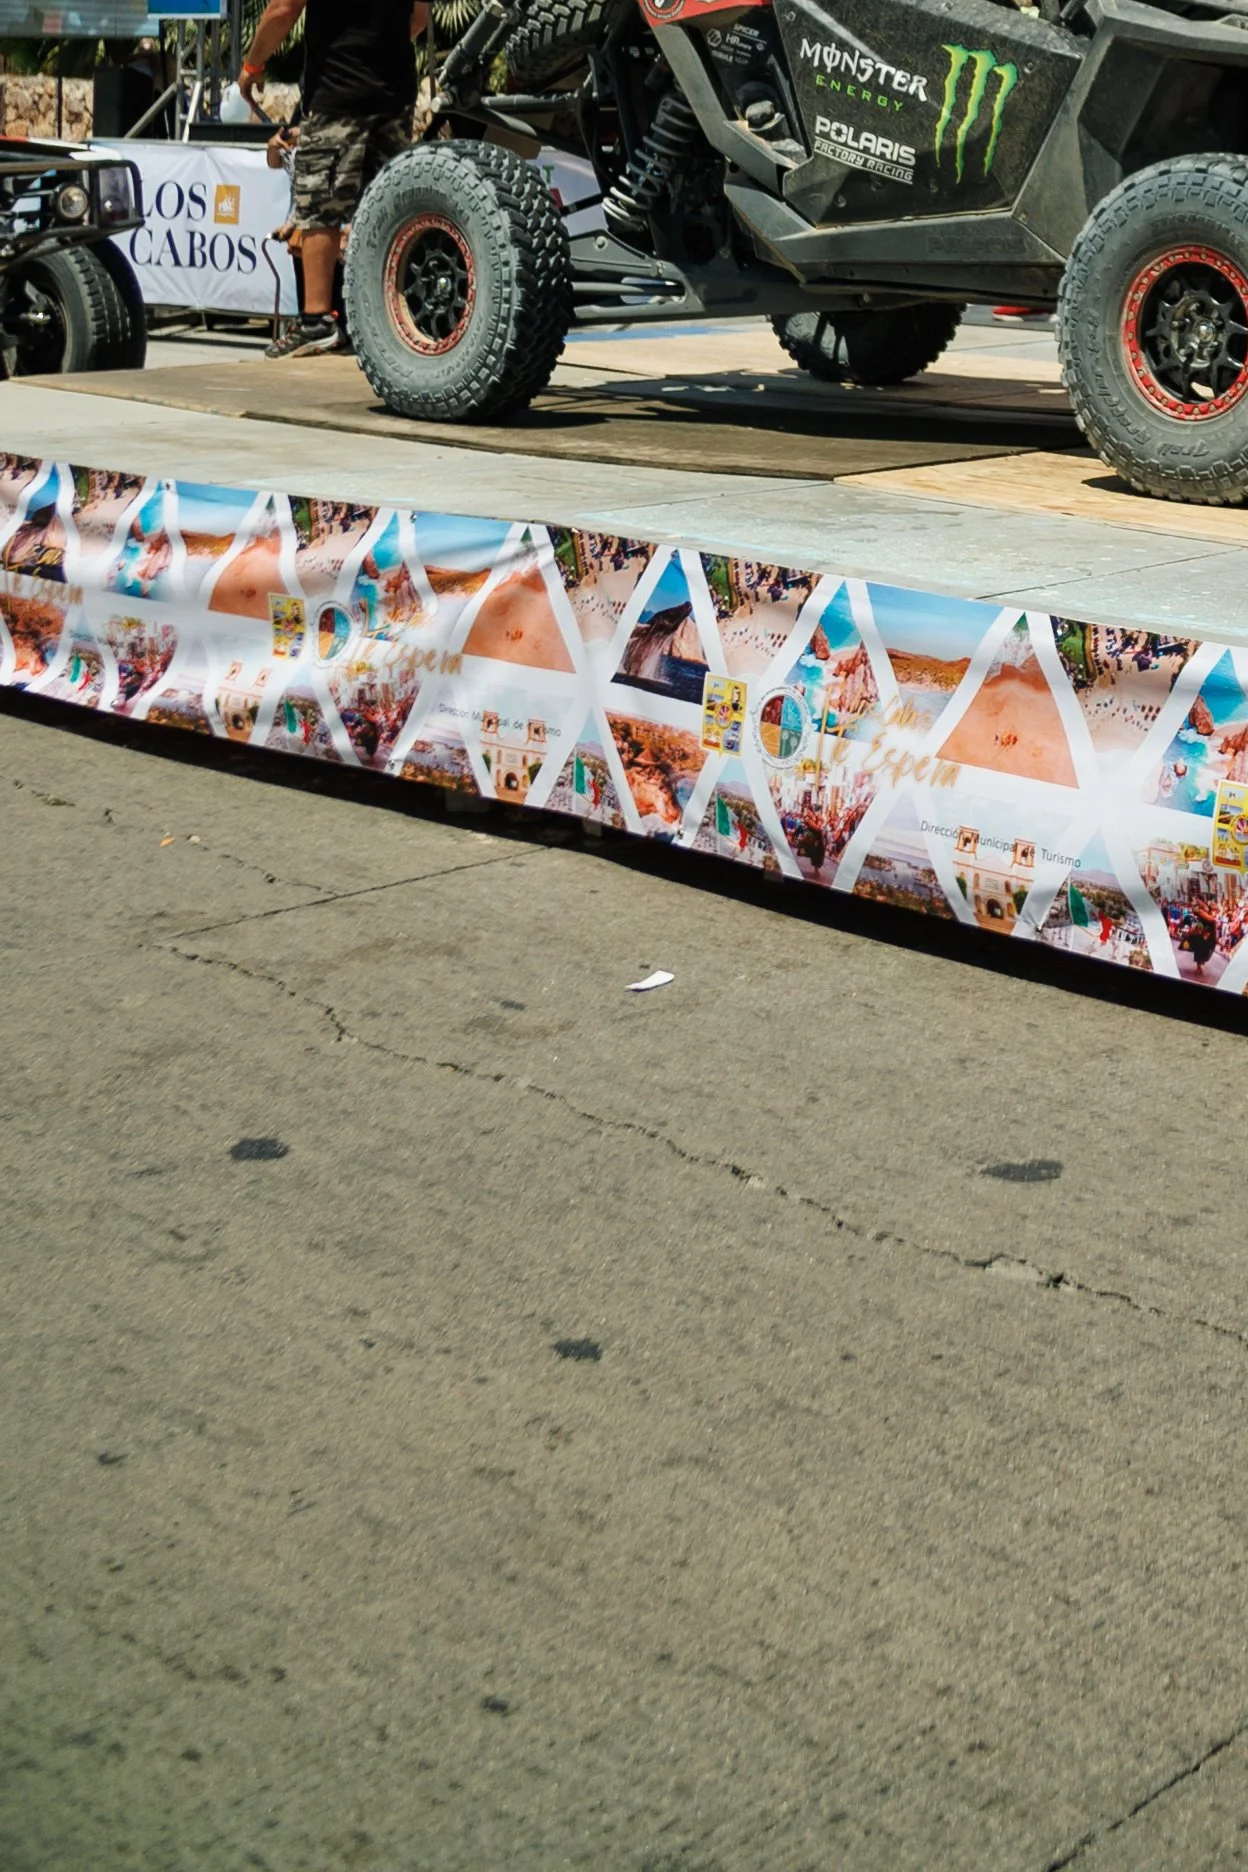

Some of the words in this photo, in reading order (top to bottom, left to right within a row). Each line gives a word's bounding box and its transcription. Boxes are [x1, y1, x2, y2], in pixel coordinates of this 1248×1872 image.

[800, 38, 928, 102] MONSTER
[816, 74, 904, 112] ENERGY
[814, 139, 863, 166] FACTORY
[867, 159, 914, 181] RACING
[815, 116, 916, 166] POLARIS
[129, 227, 257, 274] CABOS
[1041, 848, 1082, 868] Turismo
